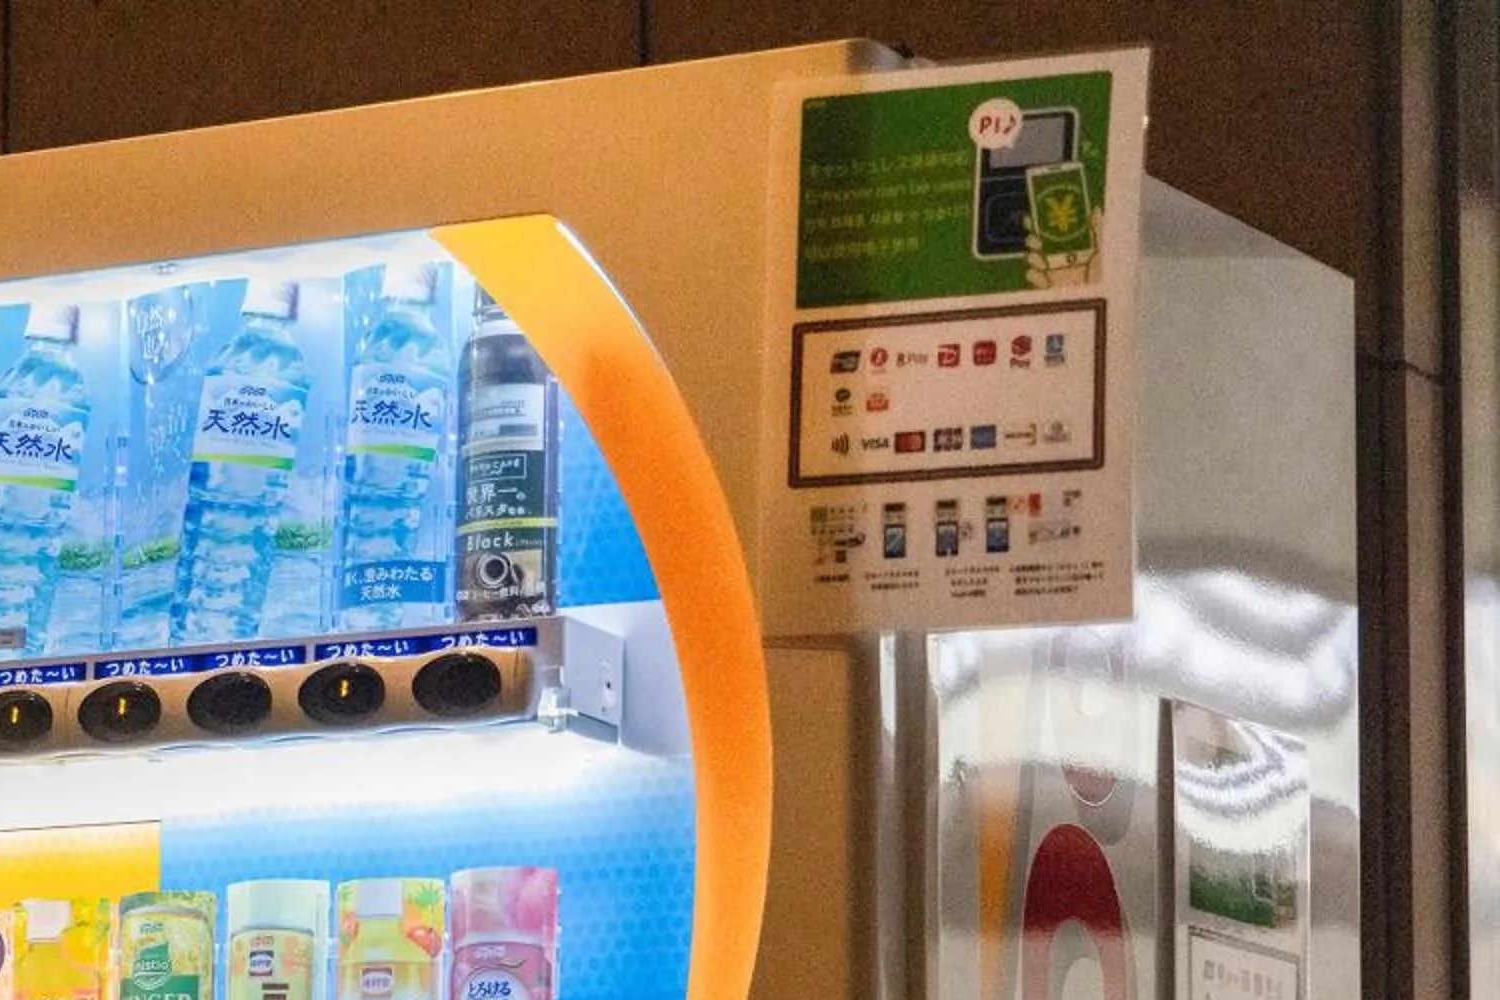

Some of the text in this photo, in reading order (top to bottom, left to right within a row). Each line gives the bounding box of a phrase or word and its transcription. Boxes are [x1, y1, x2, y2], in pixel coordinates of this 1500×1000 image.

[202, 409, 292, 440] 天然水
[351, 399, 433, 430] 天然水
[861, 437, 889, 451] VISA
[467, 531, 514, 553] Black
[467, 980, 512, 999] とろける
